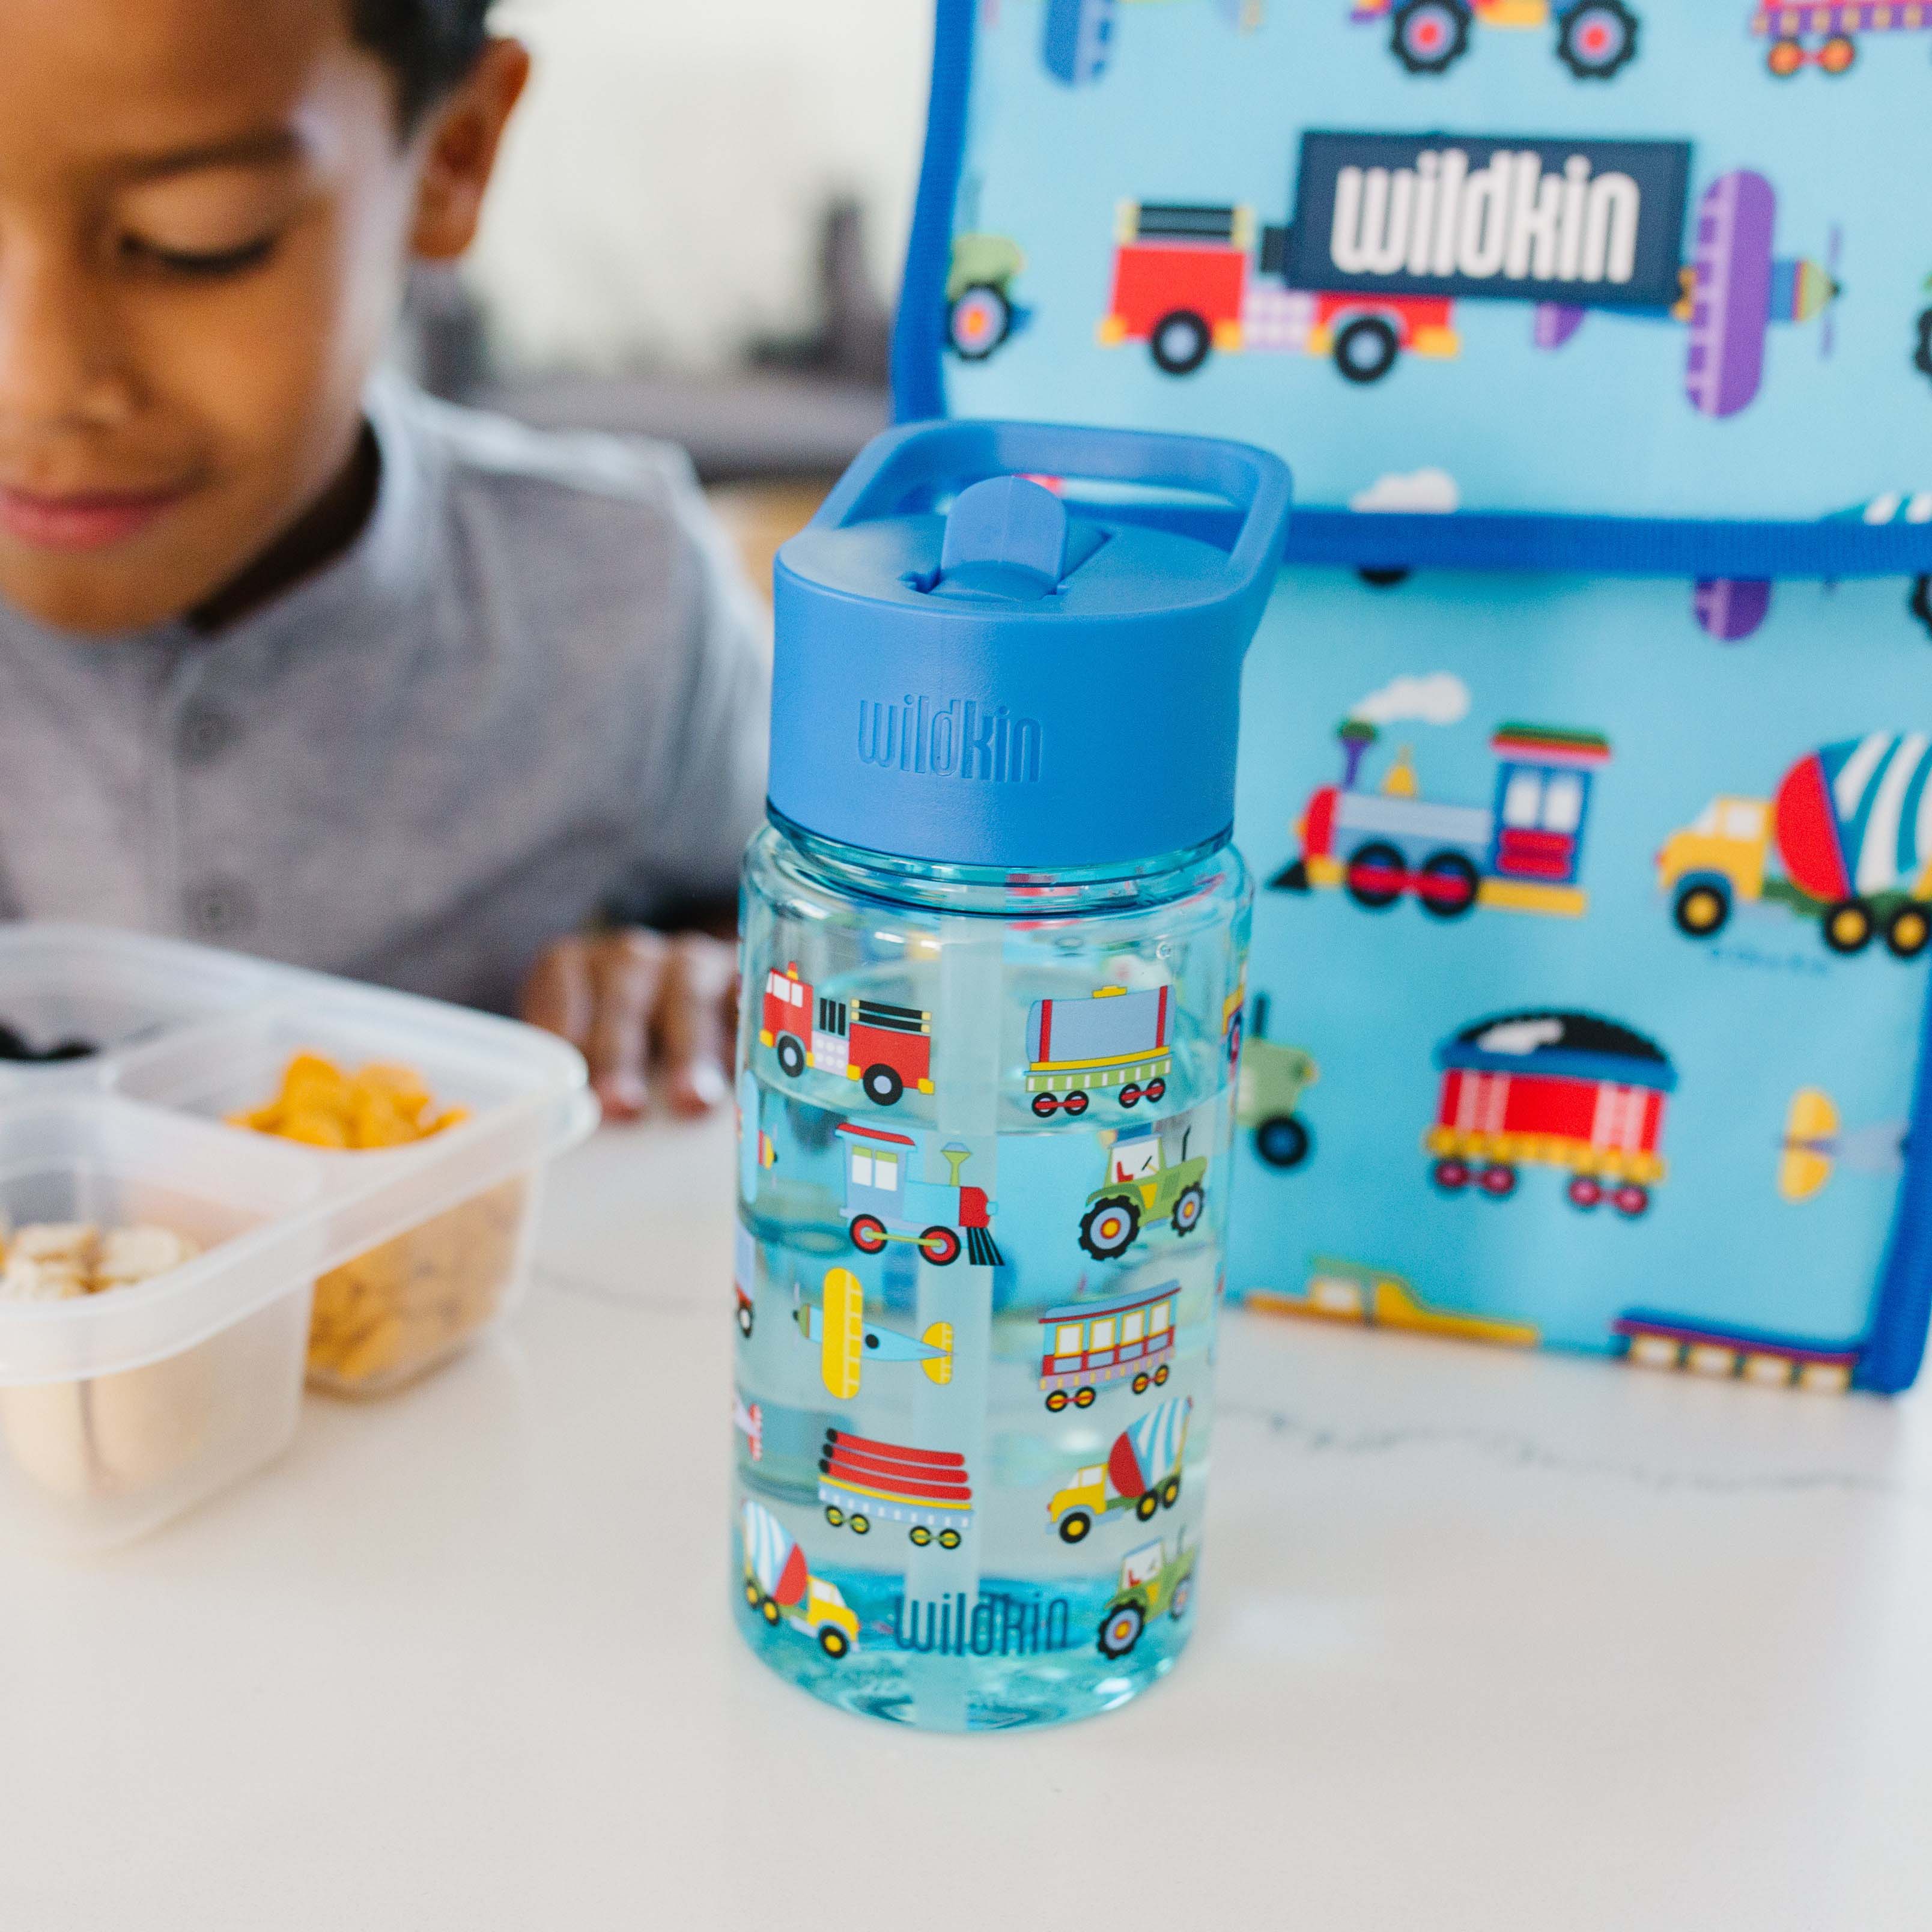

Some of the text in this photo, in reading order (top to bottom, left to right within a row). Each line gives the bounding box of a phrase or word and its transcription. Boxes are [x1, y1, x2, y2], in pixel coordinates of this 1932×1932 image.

[1330, 148, 1640, 284] wildkin
[858, 694, 1042, 782] wildkin
[895, 1592, 1068, 1656] wildkin
